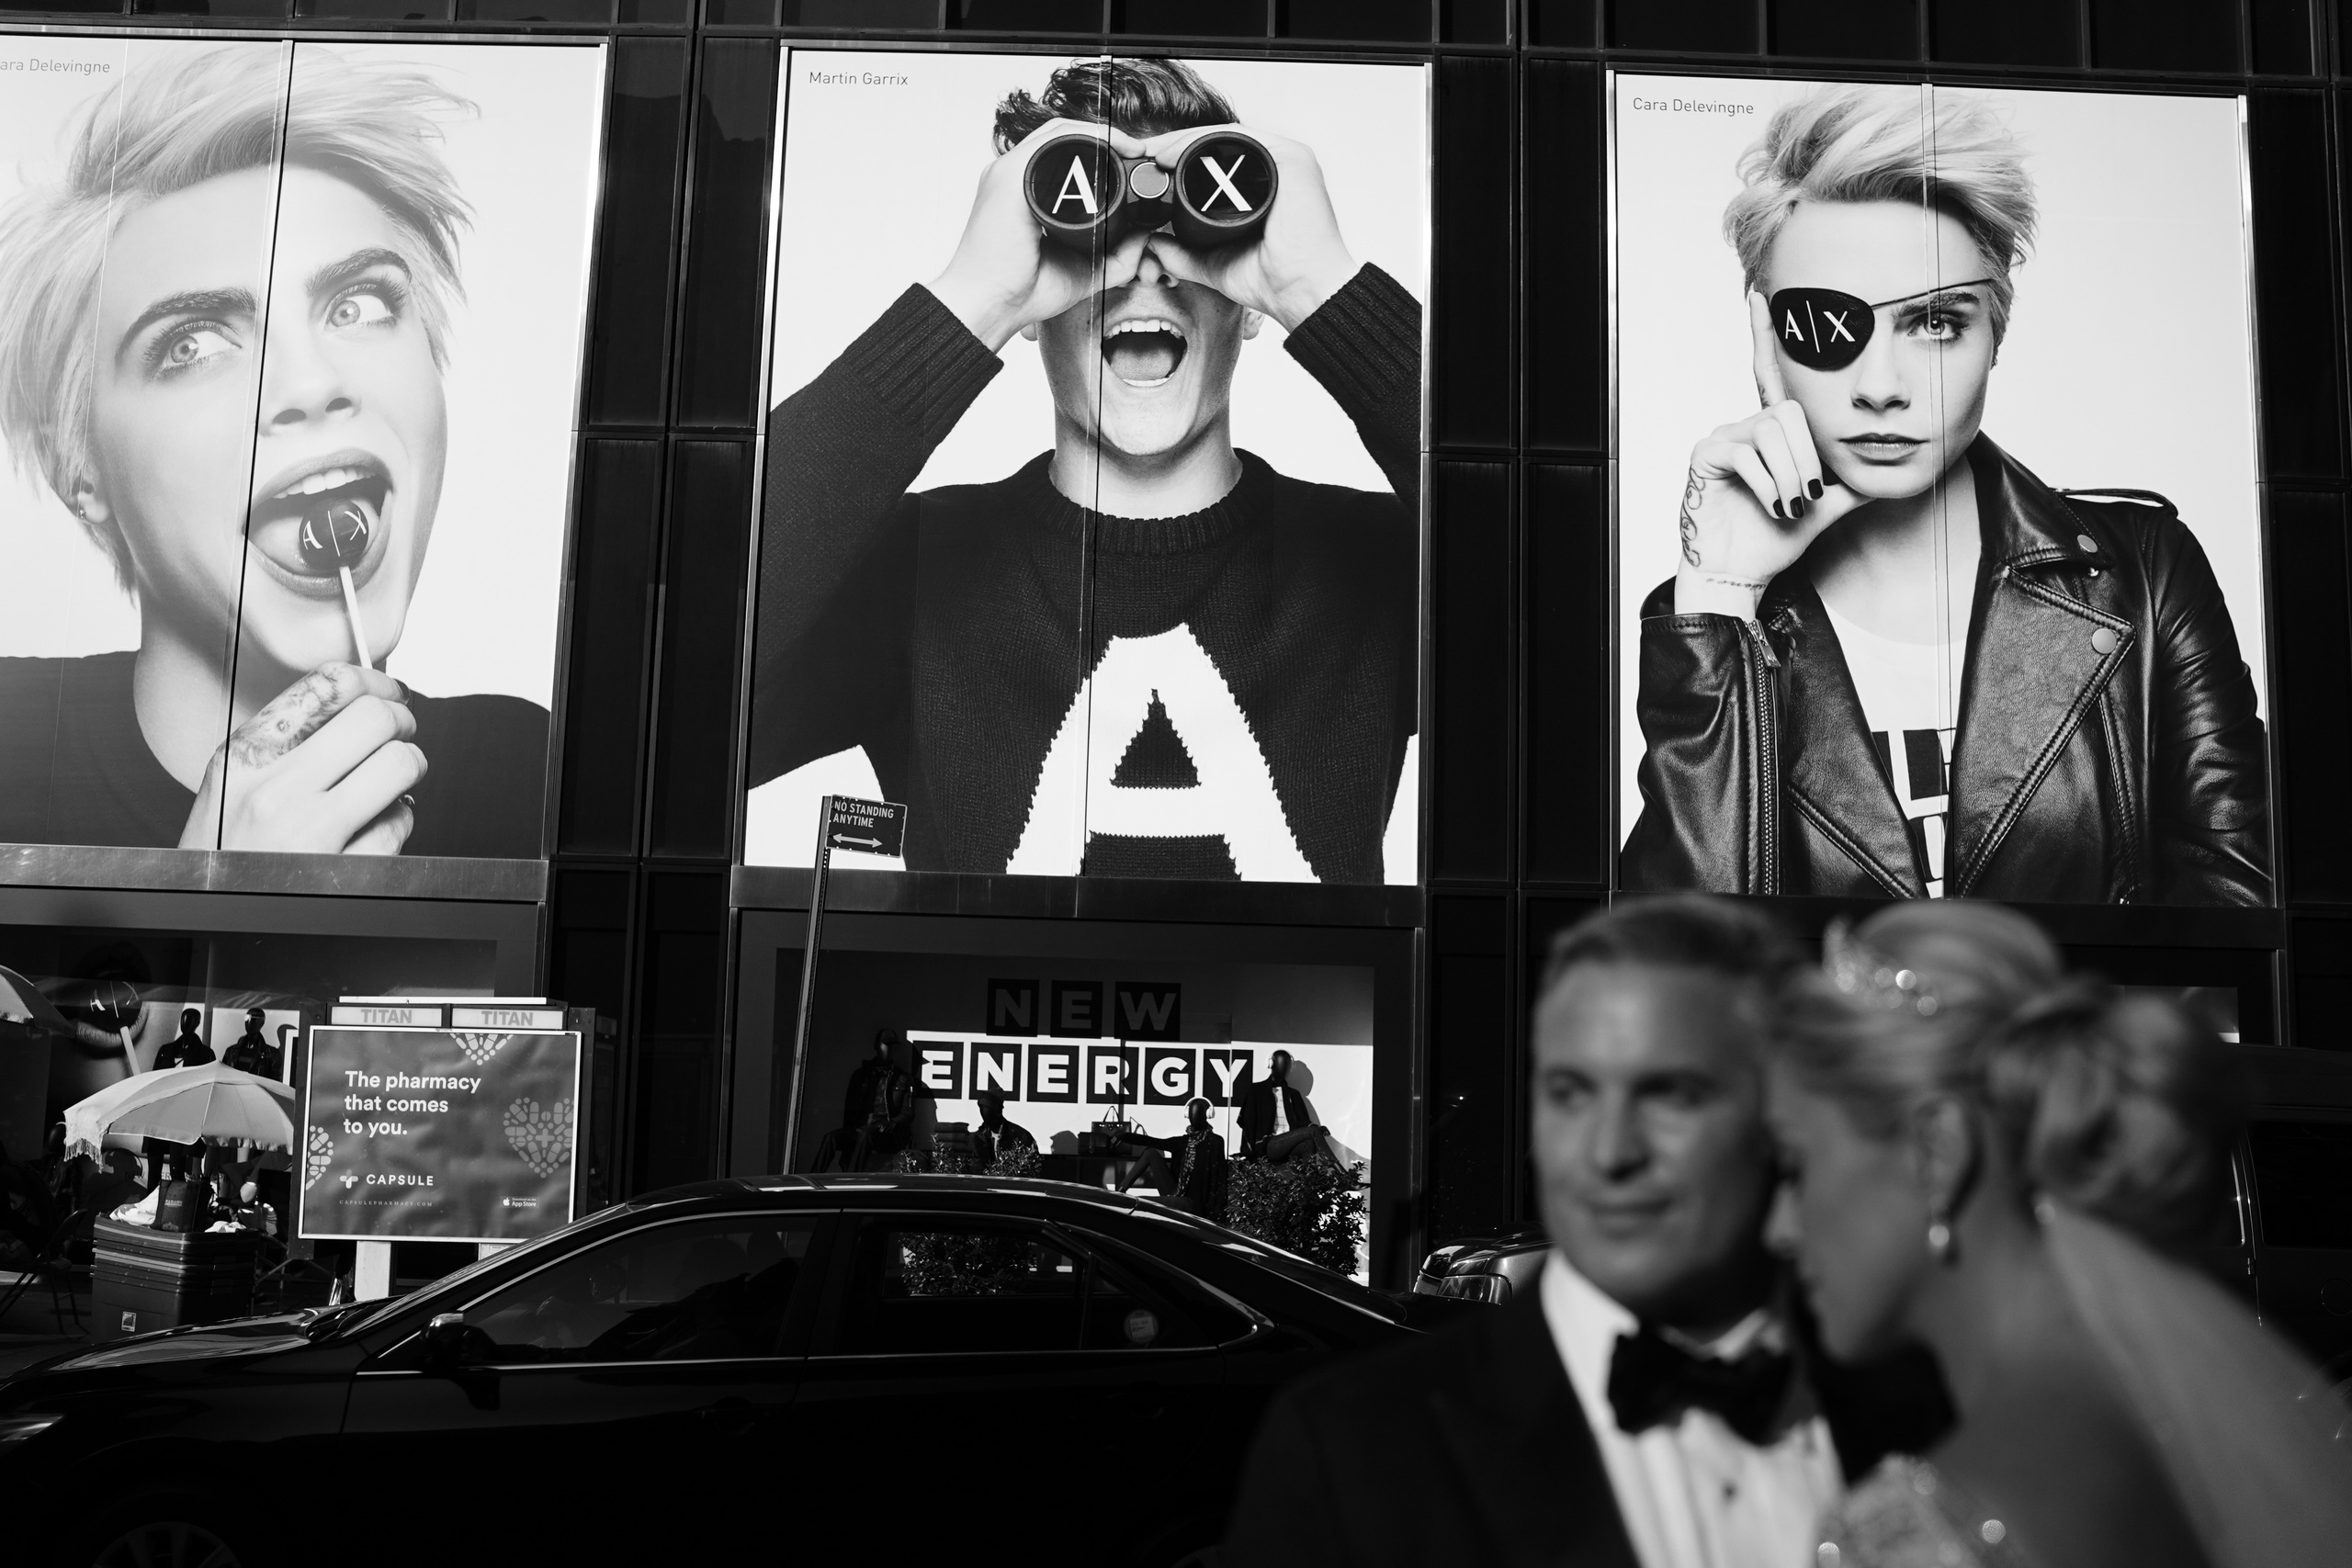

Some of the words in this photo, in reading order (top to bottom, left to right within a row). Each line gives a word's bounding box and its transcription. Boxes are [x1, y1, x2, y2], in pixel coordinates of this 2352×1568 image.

[0, 61, 24, 71] ara
[29, 58, 110, 76] Delevingne
[809, 71, 856, 85] Martin
[863, 72, 908, 85] Garrix
[1633, 96, 1668, 111] Cara
[1673, 98, 1754, 117] Delevingne
[1006, 622, 1321, 883] A
[834, 800, 847, 812] NO
[849, 803, 894, 818] STANDING
[832, 813, 875, 828] ANYTIME
[361, 1009, 413, 1024] TITAN
[481, 1010, 533, 1026] TITAN
[994, 988, 1176, 1031] NEW
[345, 1070, 380, 1089] The
[386, 1071, 481, 1094] pharmacy
[921, 1049, 1248, 1099] ENERGY
[345, 1093, 381, 1111] that
[386, 1099, 449, 1112] comes
[343, 1118, 363, 1134] to
[368, 1122, 408, 1138] you.
[366, 1174, 434, 1186] CAPSULE
